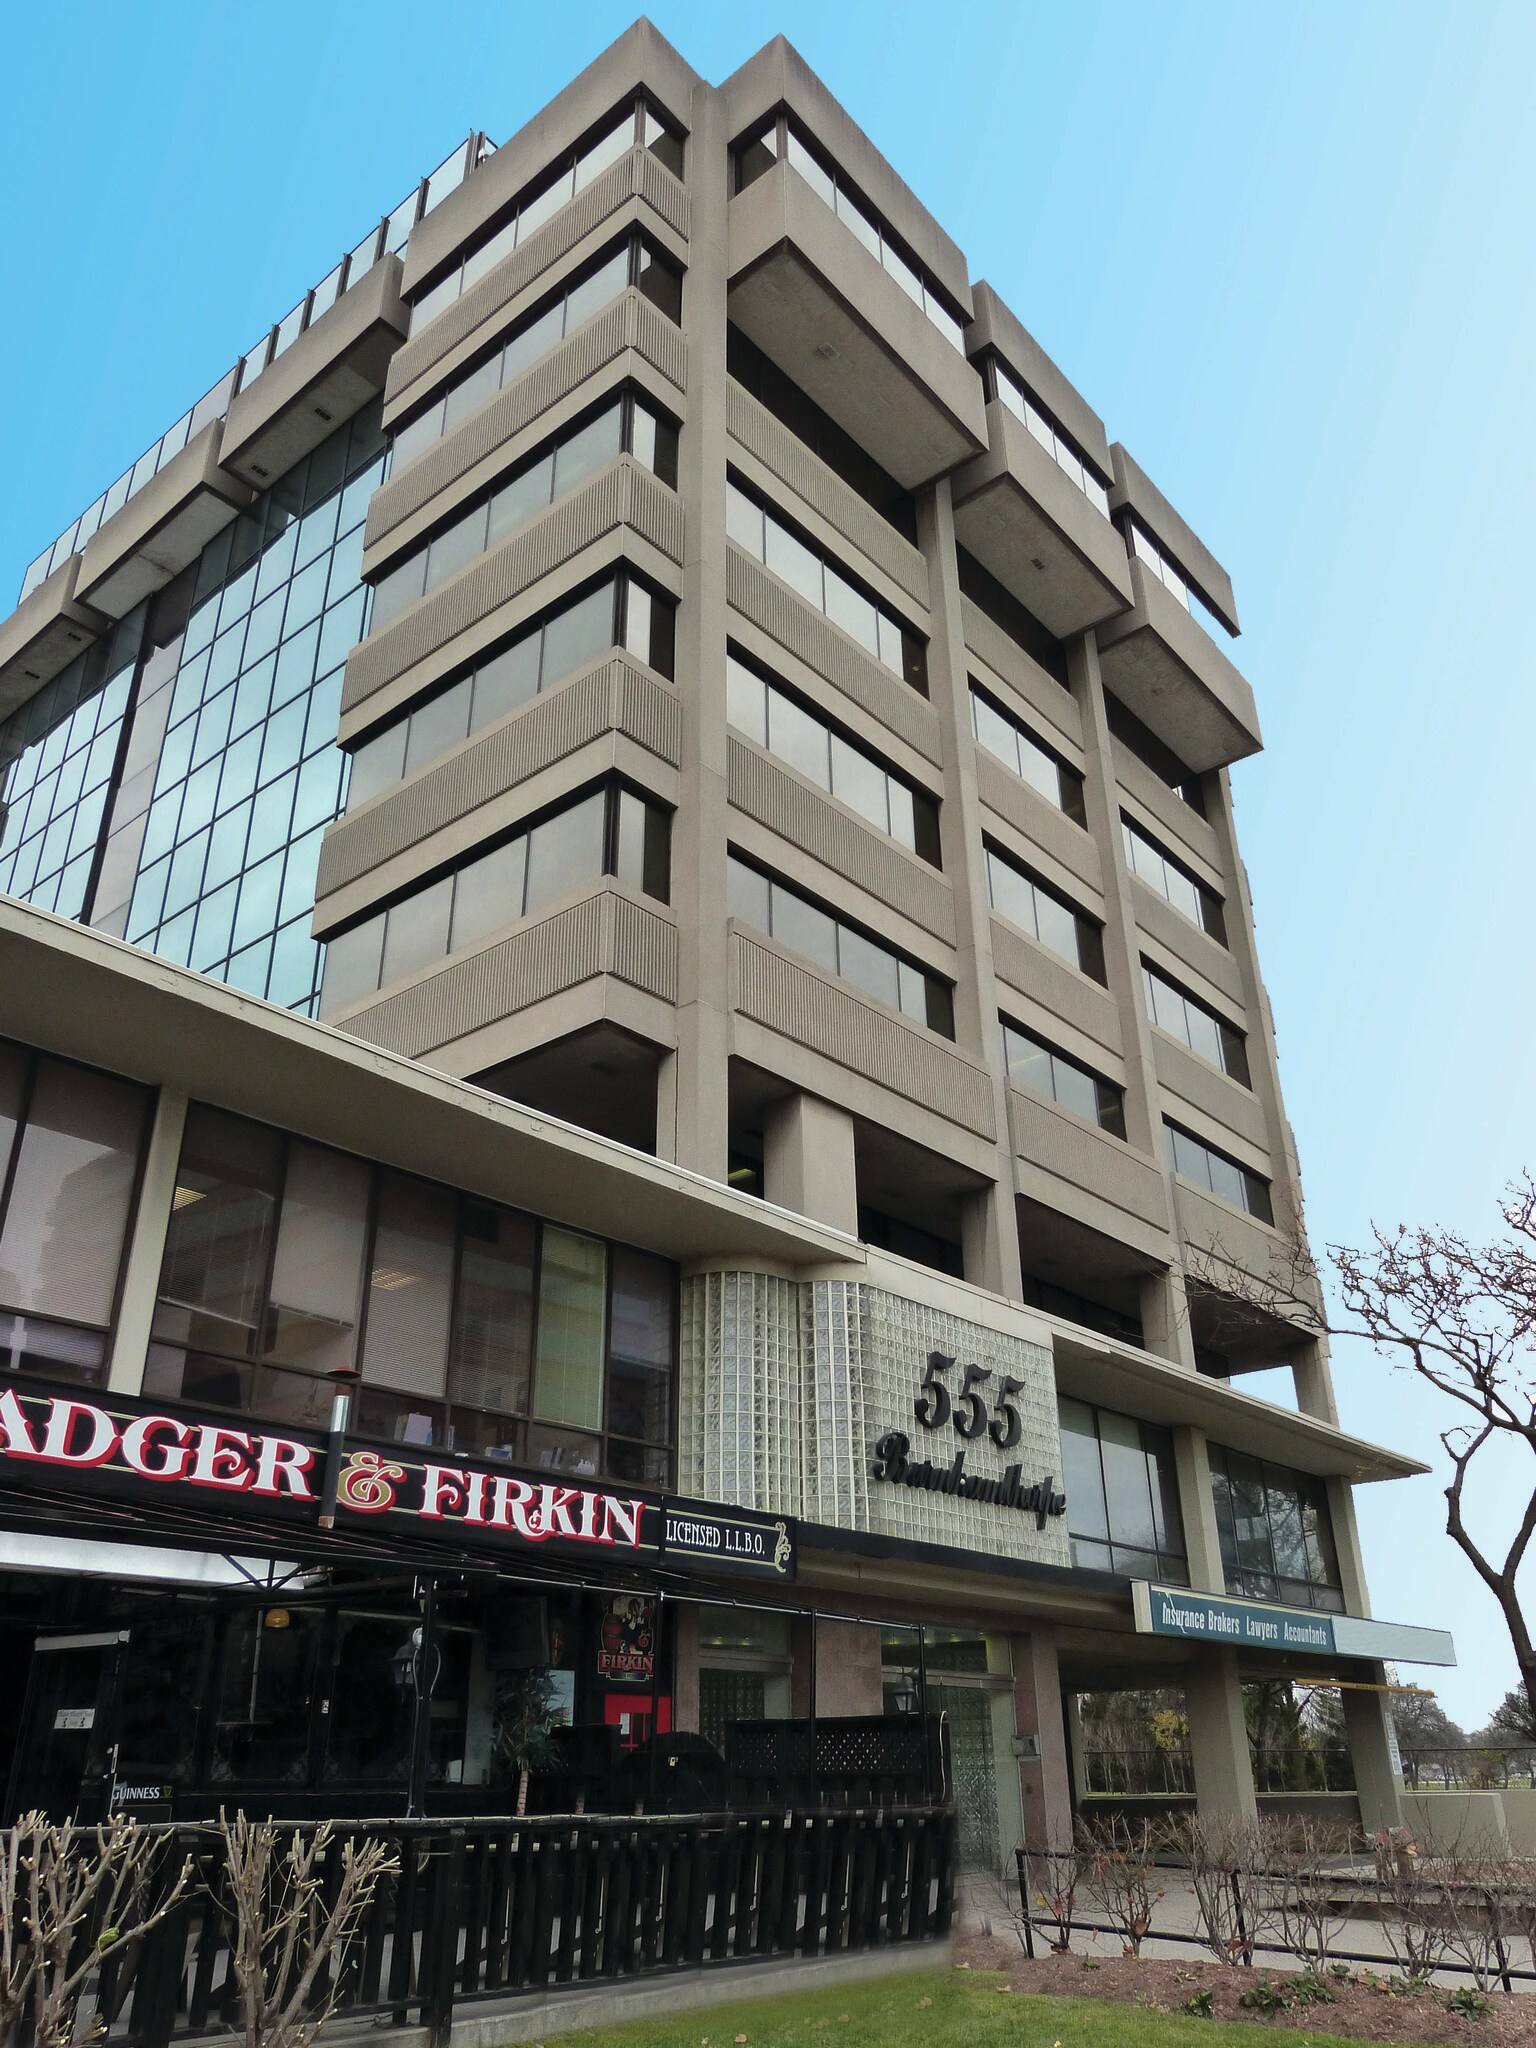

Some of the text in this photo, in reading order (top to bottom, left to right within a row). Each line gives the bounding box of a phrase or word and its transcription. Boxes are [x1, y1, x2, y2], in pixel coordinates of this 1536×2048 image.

[914, 1351, 1026, 1448] 555
[336, 1451, 408, 1514] &
[418, 1464, 646, 1550] FIRKIN
[665, 1519, 766, 1555] LICENSED L.L.B.O.
[1162, 1601, 1327, 1646] Insurance Brokers Lawyers Accountants
[601, 1653, 653, 1673] FIRKIN
[112, 1785, 160, 1800] GUINNESS
